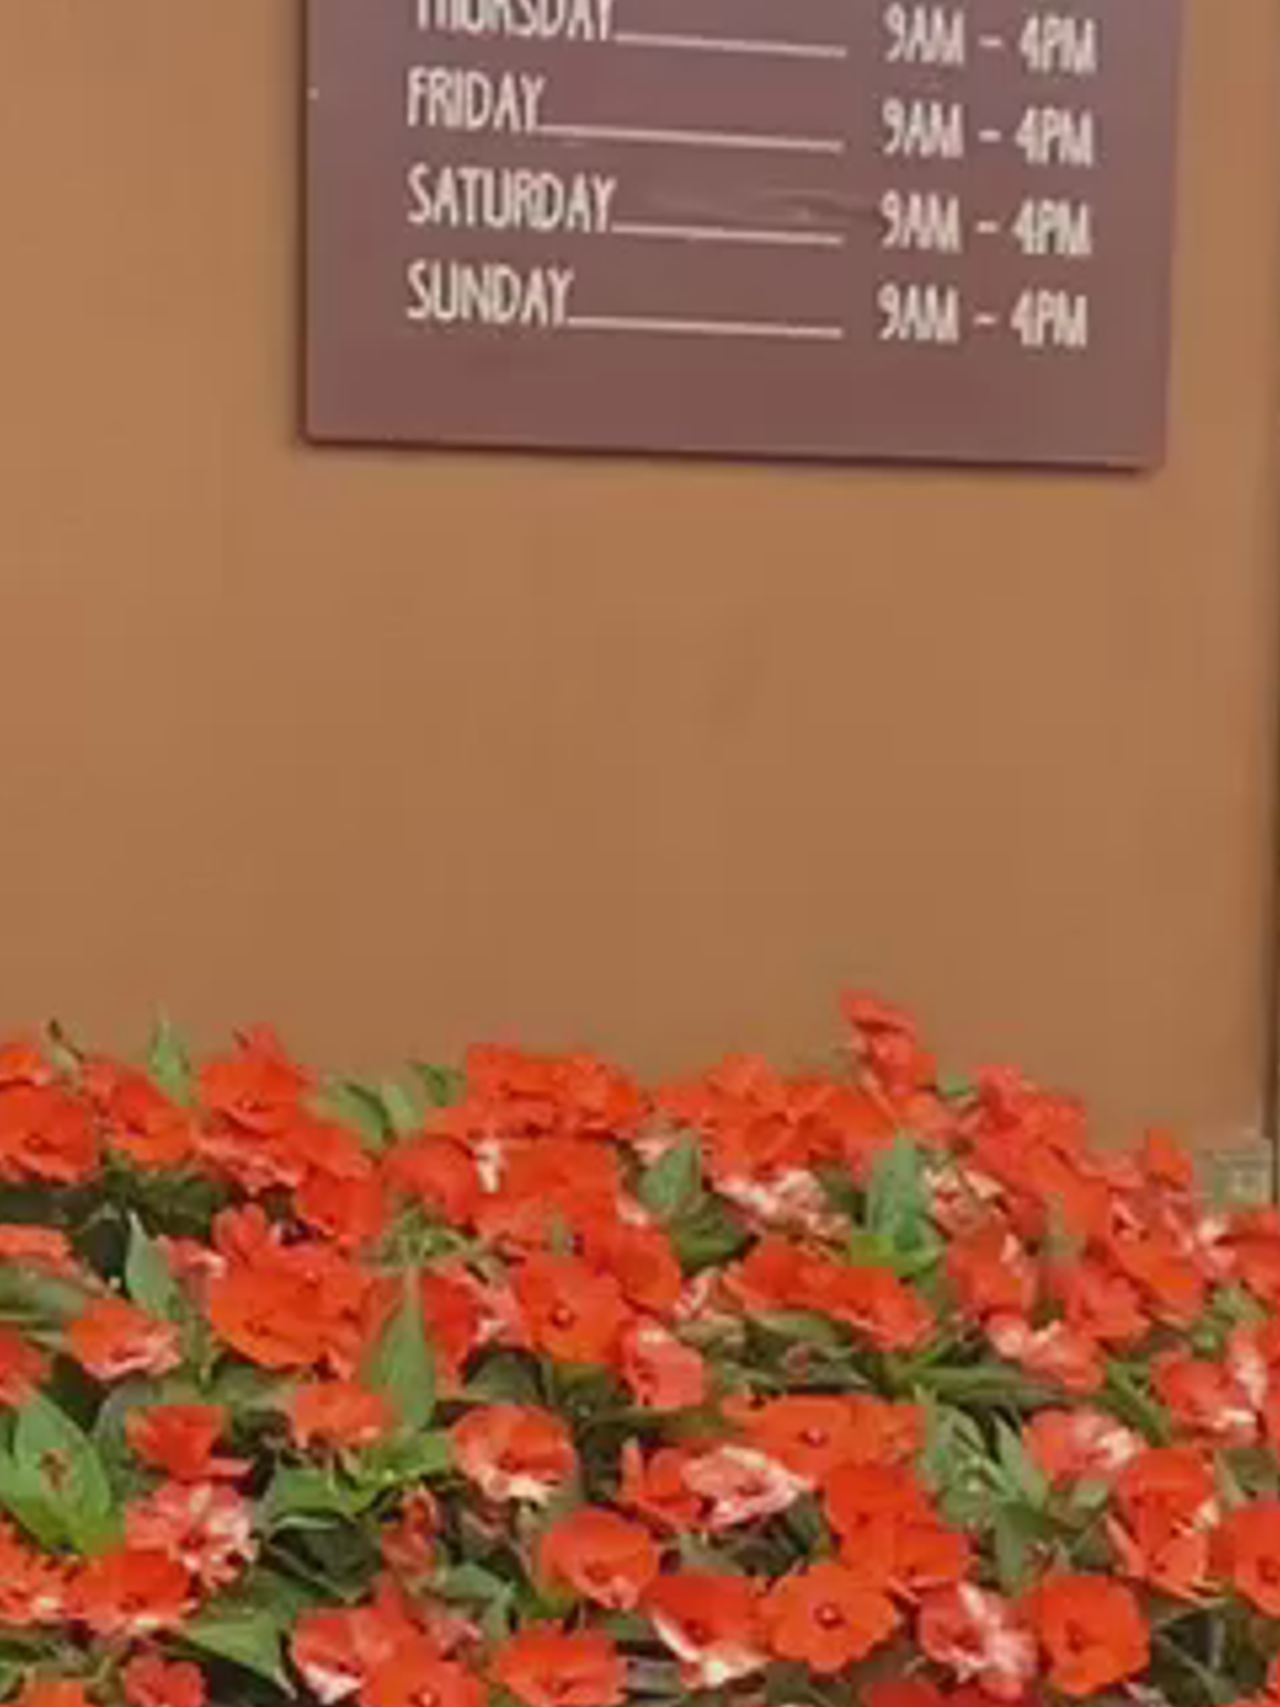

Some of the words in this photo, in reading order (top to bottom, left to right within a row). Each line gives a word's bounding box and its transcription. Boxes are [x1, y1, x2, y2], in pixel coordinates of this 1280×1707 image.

[885, 2, 965, 65] 9AM
[1019, 14, 1096, 74] 4PM
[407, 66, 548, 134] FRIDAY
[882, 98, 964, 158] 9AM
[1015, 106, 1094, 167] 4PM
[408, 162, 618, 233] SATURDAY
[881, 190, 960, 251] 9AM
[1012, 199, 1092, 256] 4PM
[406, 260, 577, 327] SUNDAY
[878, 284, 959, 342] 9AM
[1011, 289, 1087, 347] 4PM
